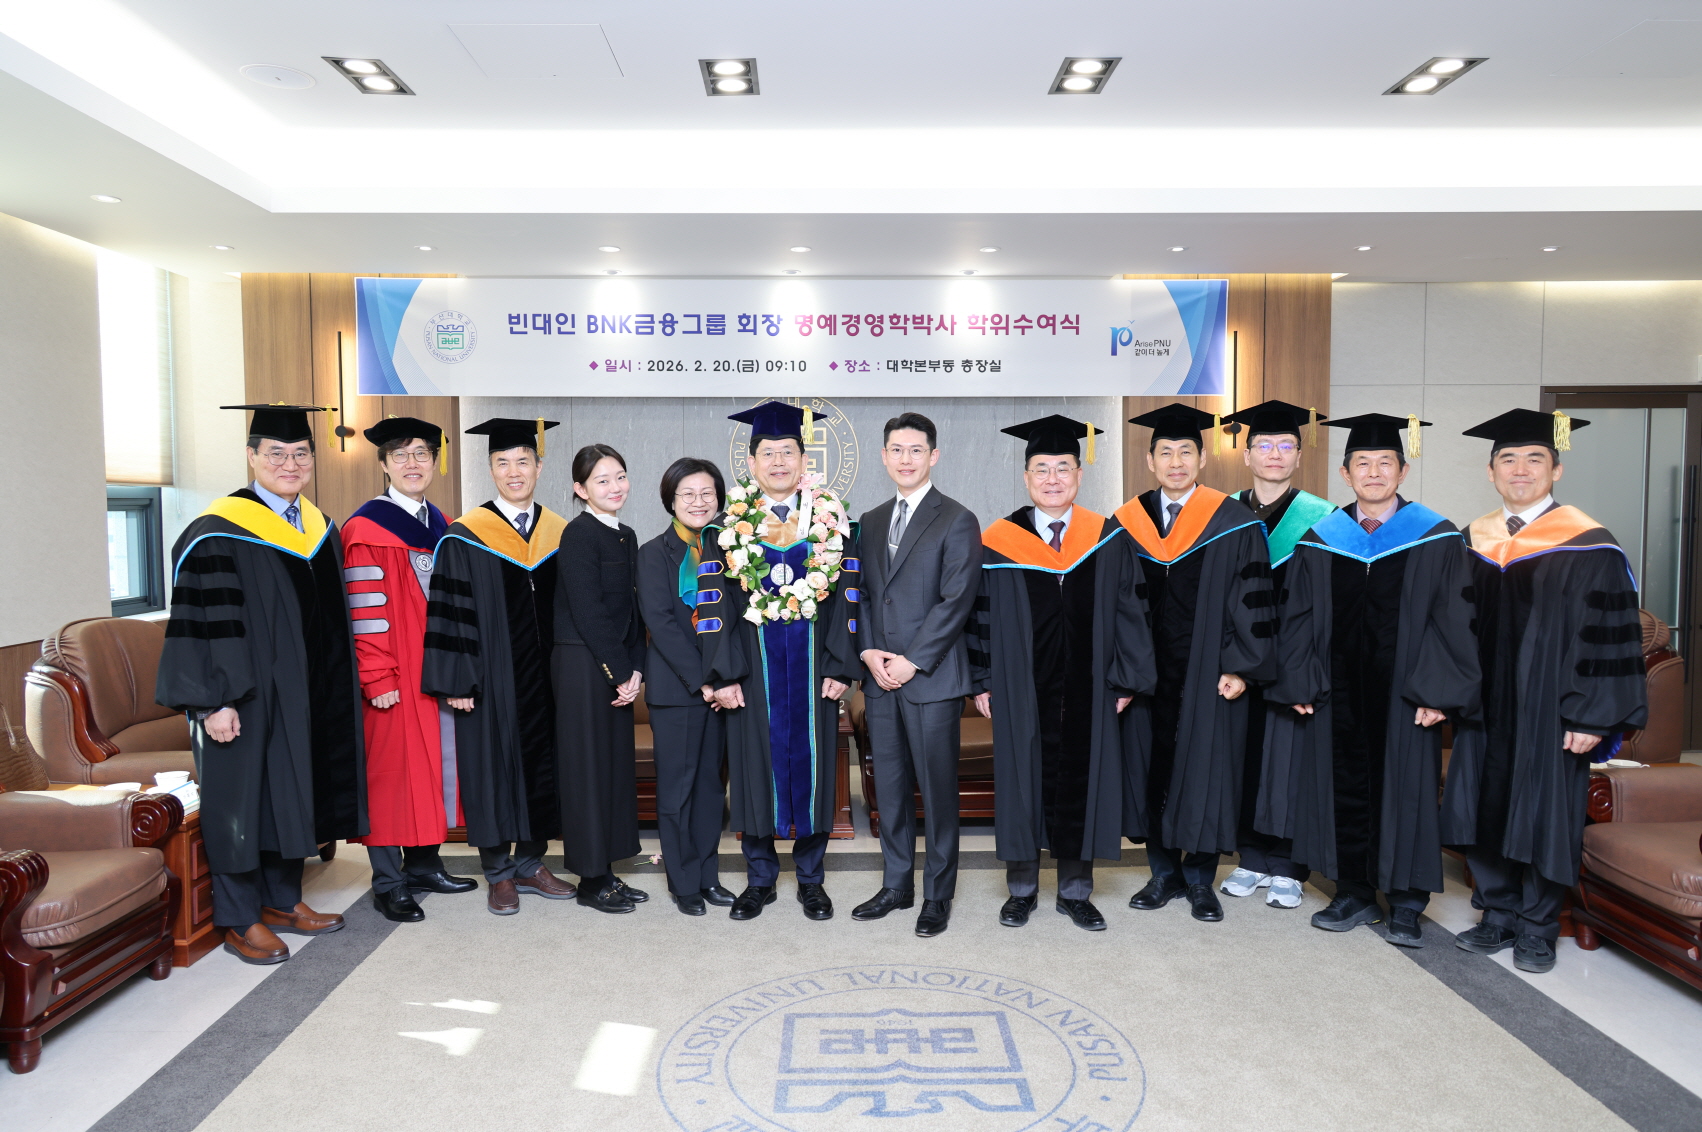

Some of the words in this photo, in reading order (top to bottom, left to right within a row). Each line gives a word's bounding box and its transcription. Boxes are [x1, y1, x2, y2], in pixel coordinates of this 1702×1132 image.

[508, 312, 576, 335] 빈대인
[586, 312, 727, 337] BNK금융그룹
[737, 312, 784, 337] 회장
[794, 312, 958, 338] 명예경영학박사
[967, 313, 1080, 336] 학위수여식
[604, 359, 632, 373] 일시
[647, 359, 689, 372] 2026.
[694, 359, 707, 372] 2.
[713, 359, 760, 374] 20.(금)
[765, 359, 807, 373] 09:10
[844, 359, 871, 374] 장소
[886, 359, 955, 374] 대학본부동
[960, 358, 1002, 374] 총장실
[831, 441, 855, 497] IVERSITY
[833, 970, 1050, 1010] NATIONAL
[675, 978, 826, 1087] UNIVERSITY
[1044, 1009, 1128, 1082] PUSAN
